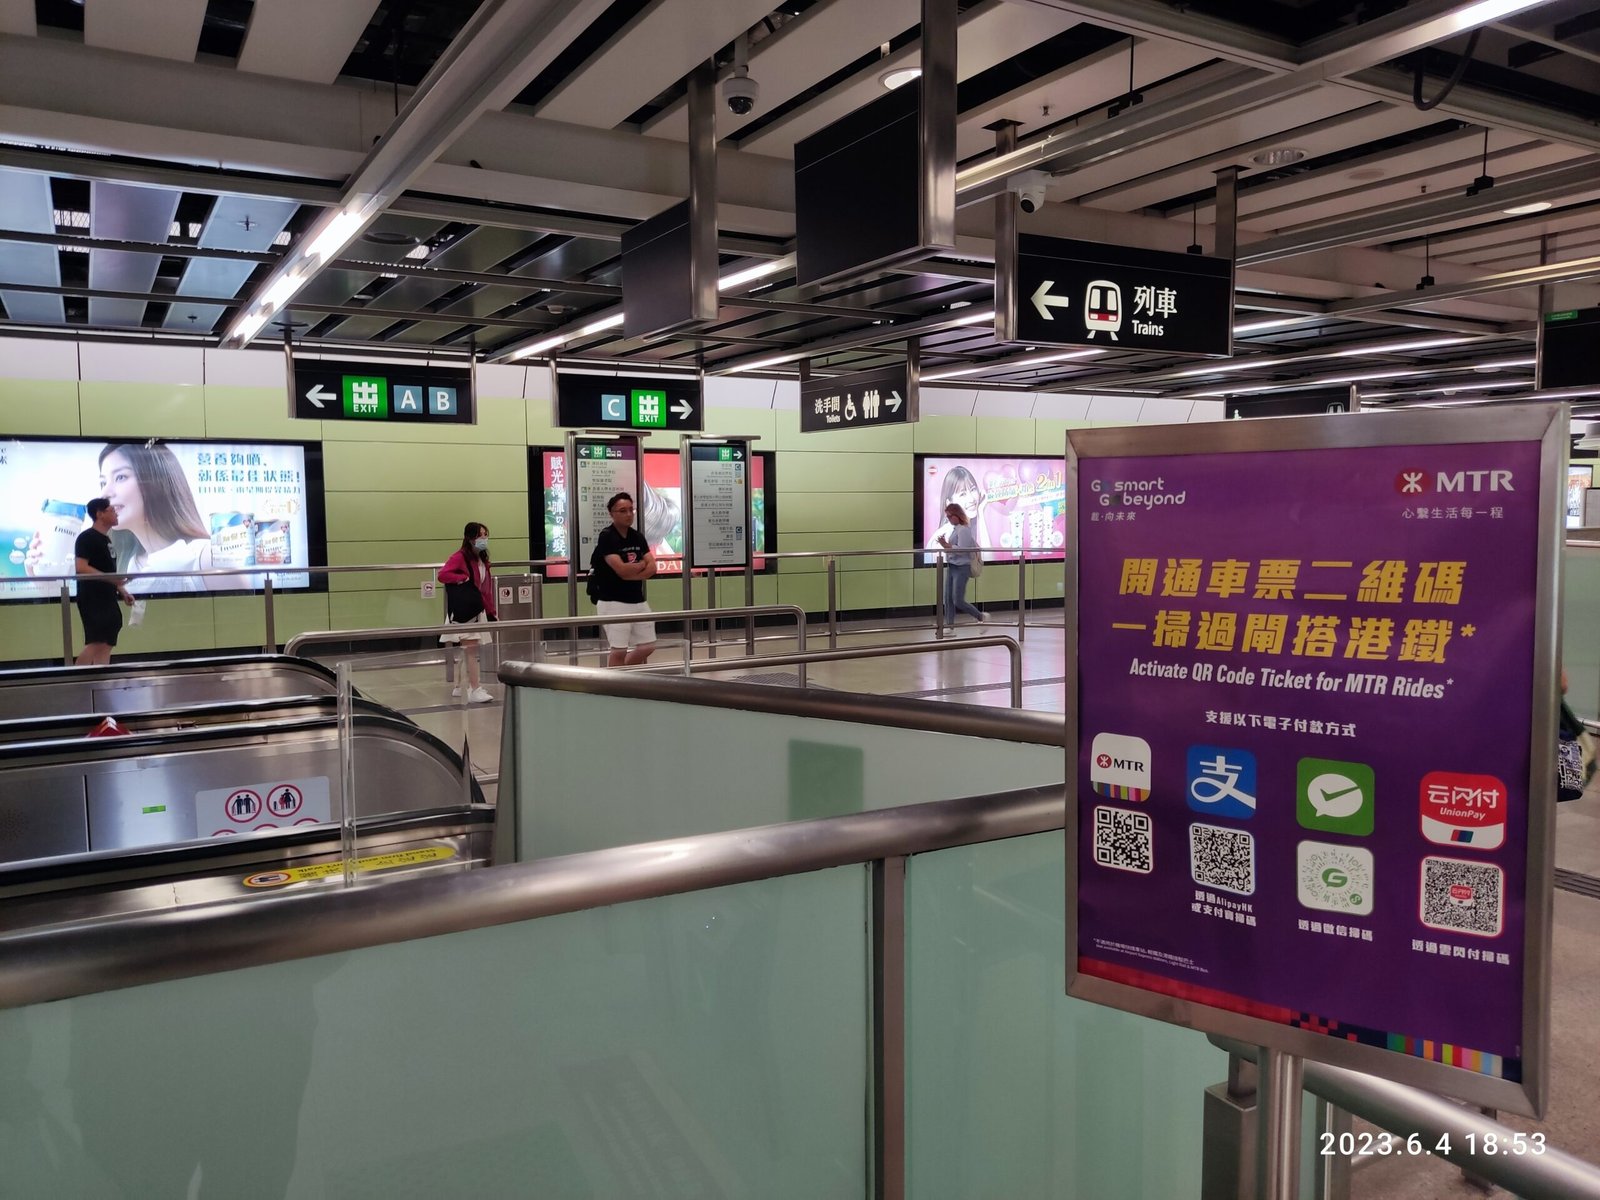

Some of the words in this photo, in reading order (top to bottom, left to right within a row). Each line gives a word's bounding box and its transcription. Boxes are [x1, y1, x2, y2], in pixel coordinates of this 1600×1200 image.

[1133, 286, 1178, 318] 列車
[1132, 320, 1164, 336] Trains
[353, 404, 378, 413] EXIT
[400, 390, 417, 409] A
[436, 392, 450, 411] B
[607, 399, 620, 417] C
[814, 396, 840, 415] 洗手間
[639, 414, 659, 423] EXIT
[826, 414, 841, 423] Toilets
[1114, 477, 1164, 491] smart
[1436, 470, 1515, 493] MTR
[1123, 490, 1186, 510] beyond
[1119, 558, 1467, 604] 開通車票二維碼
[1130, 658, 1188, 679] Activate
[1192, 662, 1213, 682] QR
[1216, 665, 1255, 685] Code
[1260, 668, 1312, 689] Ticket
[1315, 671, 1342, 691] for
[1344, 673, 1388, 695] MTR
[1205, 710, 1357, 738] 支援以下電子付款方式
[1113, 758, 1144, 772] MTR
[1440, 807, 1486, 821] UnionPay
